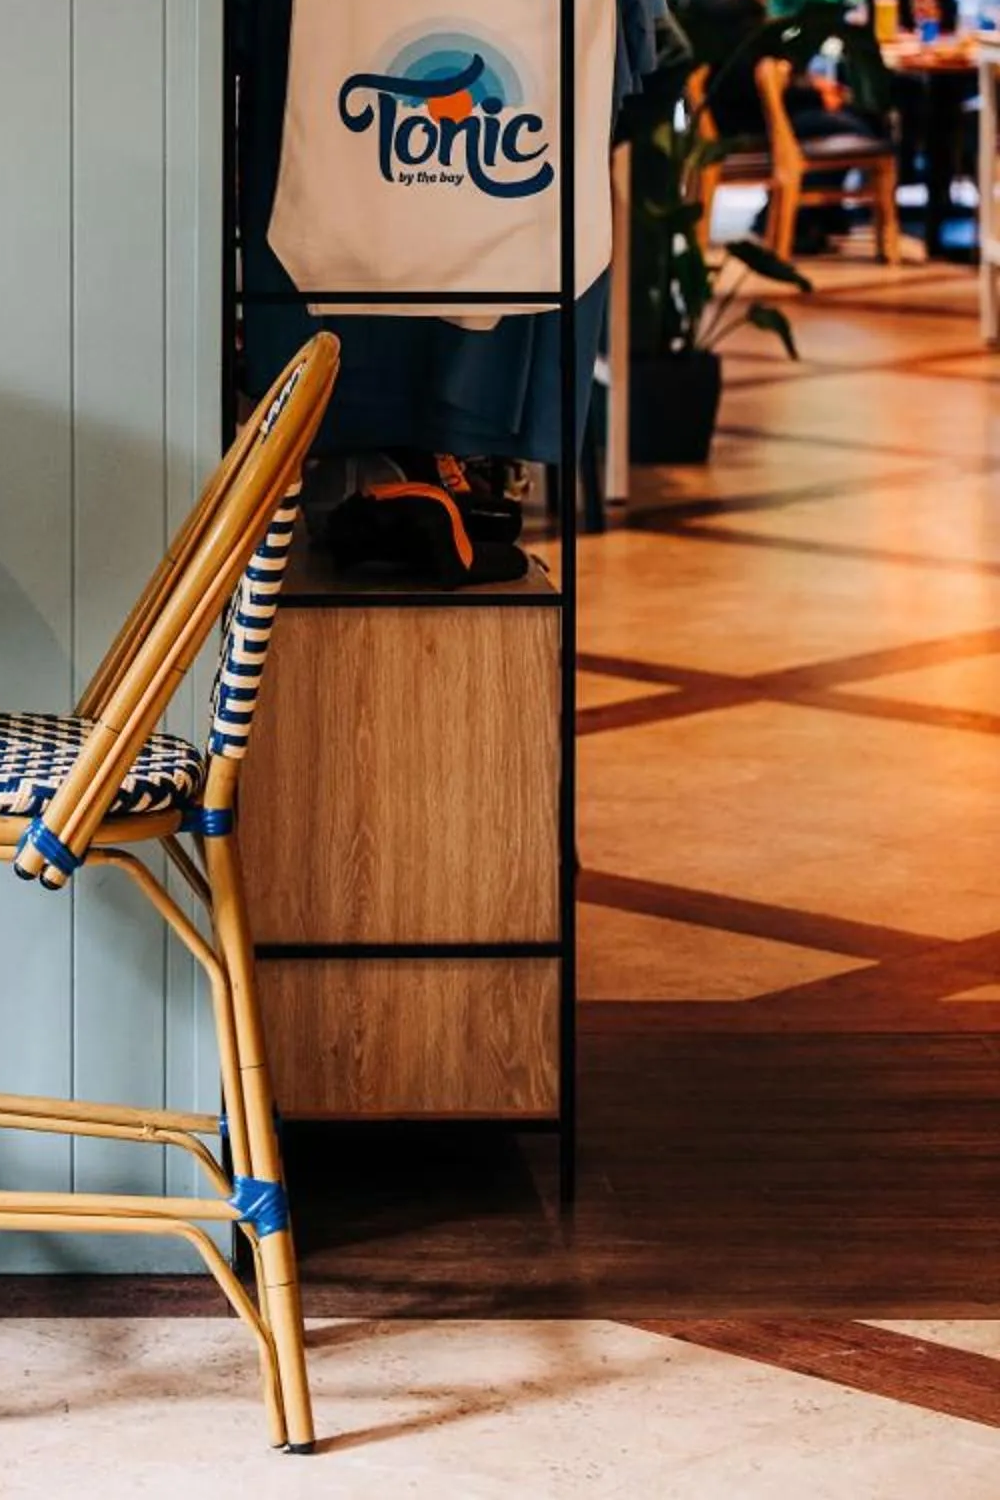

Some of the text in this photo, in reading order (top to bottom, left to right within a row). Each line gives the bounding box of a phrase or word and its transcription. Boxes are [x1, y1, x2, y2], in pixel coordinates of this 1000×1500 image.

[339, 53, 555, 198] Tonic
[399, 171, 464, 186] by the bay
